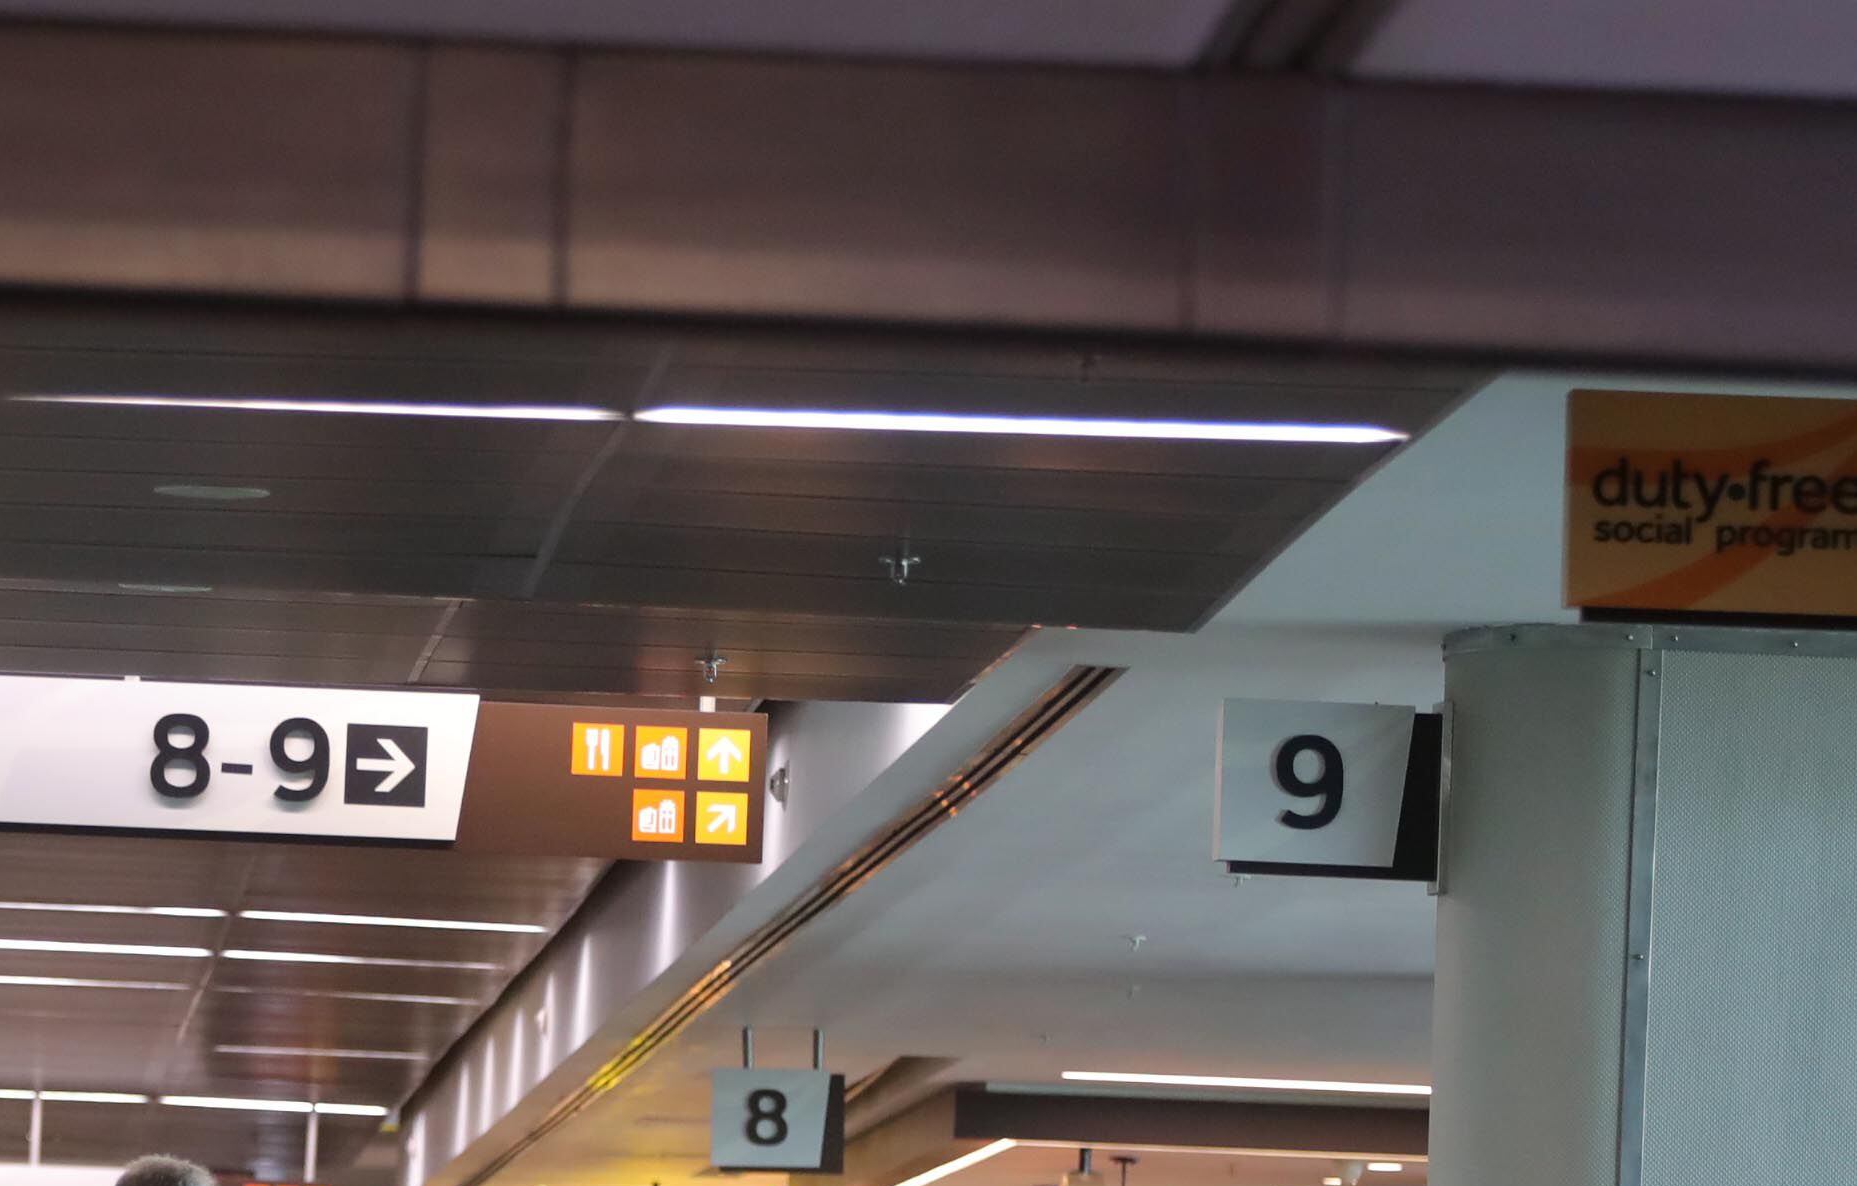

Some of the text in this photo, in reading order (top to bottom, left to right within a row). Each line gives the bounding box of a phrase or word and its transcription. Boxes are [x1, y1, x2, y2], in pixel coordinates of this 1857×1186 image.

[1594, 515, 1691, 545] social
[150, 713, 330, 802] 8-9
[1273, 734, 1344, 830] 9
[746, 1089, 788, 1145] 8
